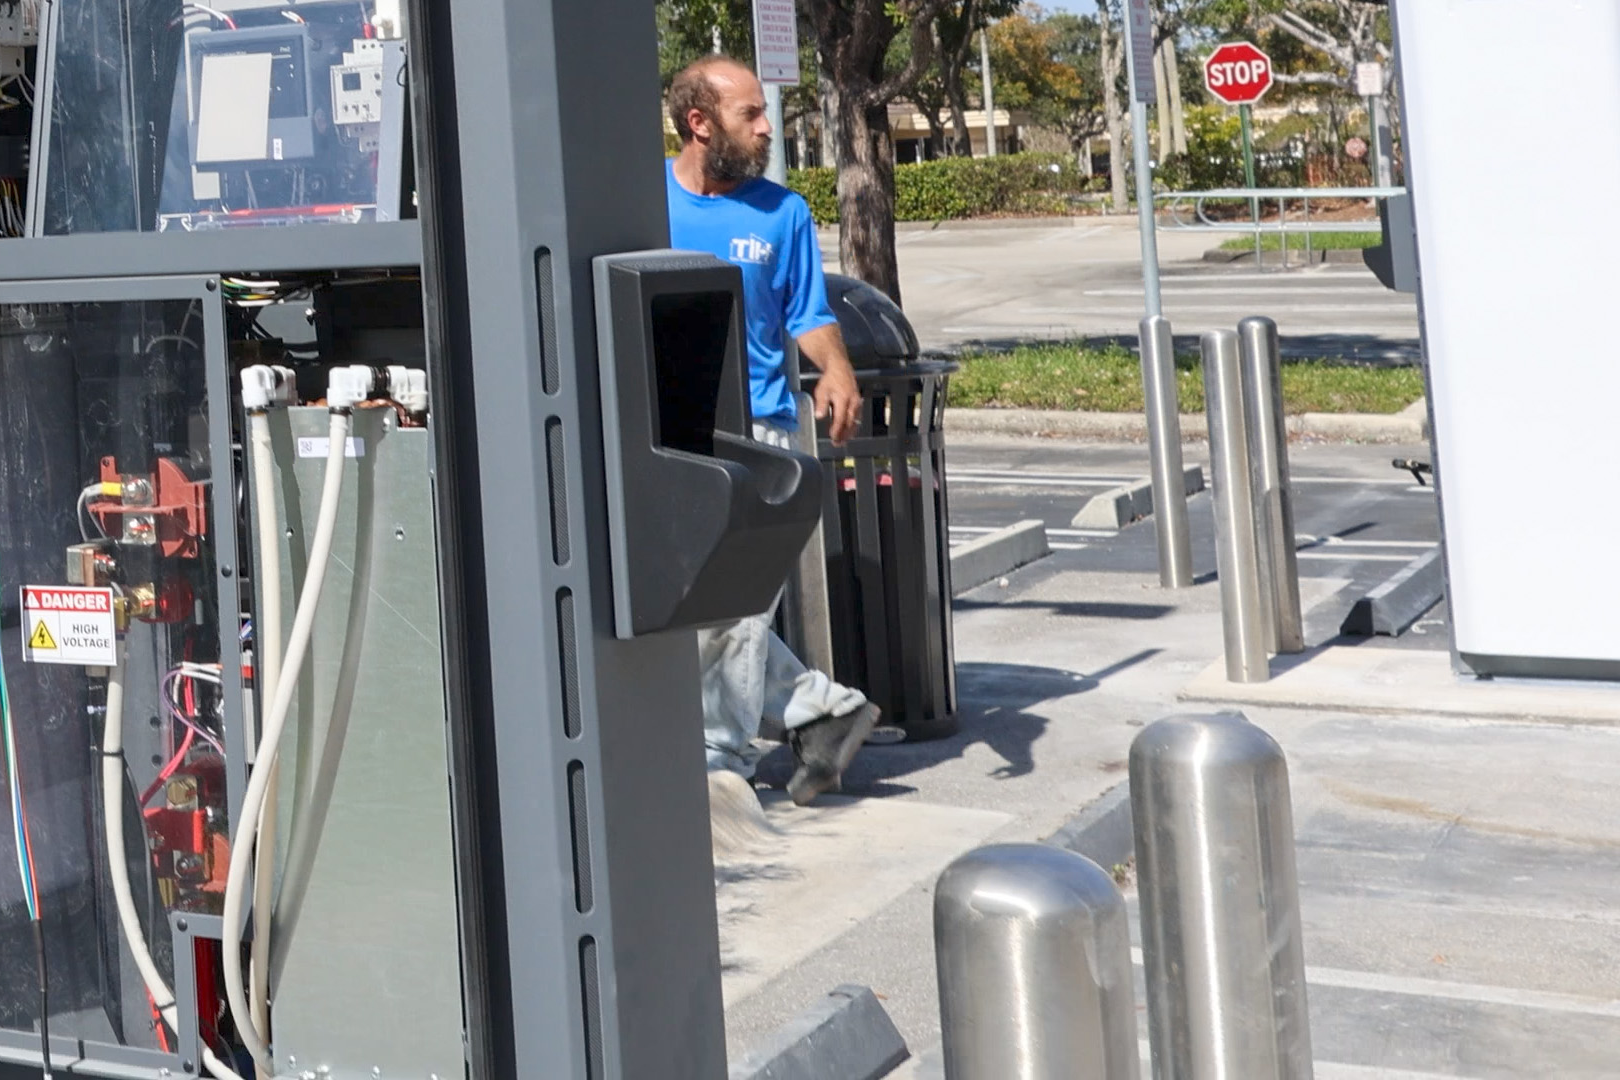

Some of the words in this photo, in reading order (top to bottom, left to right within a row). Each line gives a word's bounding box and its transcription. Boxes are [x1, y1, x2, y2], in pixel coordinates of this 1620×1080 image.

[1209, 59, 1266, 87] STOP
[41, 591, 108, 610] DANGER
[72, 623, 99, 635] HIGH
[62, 637, 110, 649] VOLTAGE
